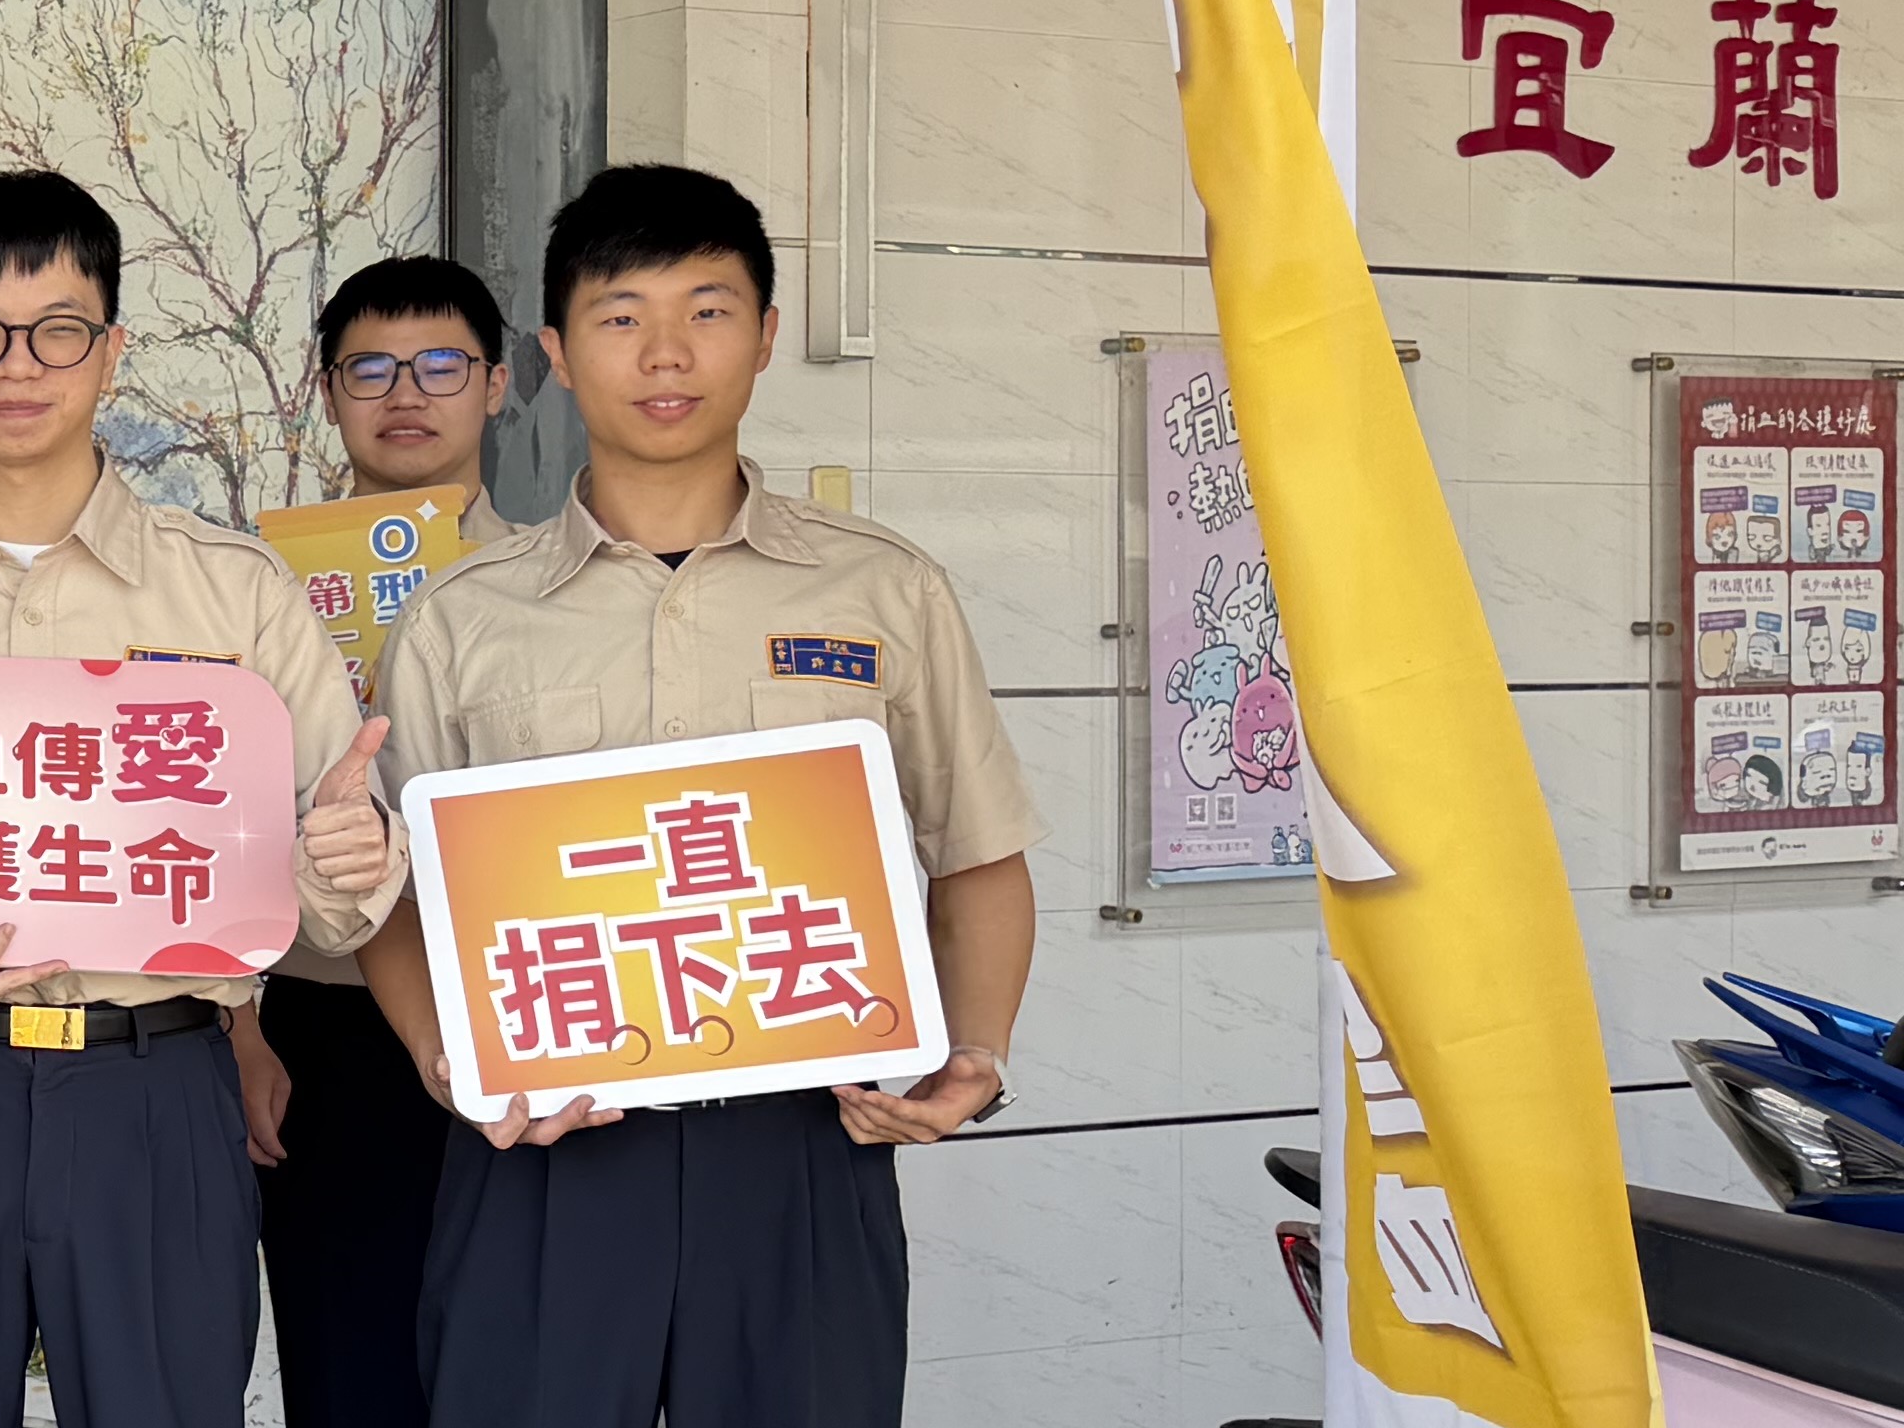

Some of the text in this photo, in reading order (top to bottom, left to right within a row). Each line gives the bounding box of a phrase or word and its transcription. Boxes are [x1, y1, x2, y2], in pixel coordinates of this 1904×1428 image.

[1740, 404, 1877, 437] 捐血的各種好處
[562, 793, 765, 905] 一直
[486, 885, 884, 1063] 捐下去
